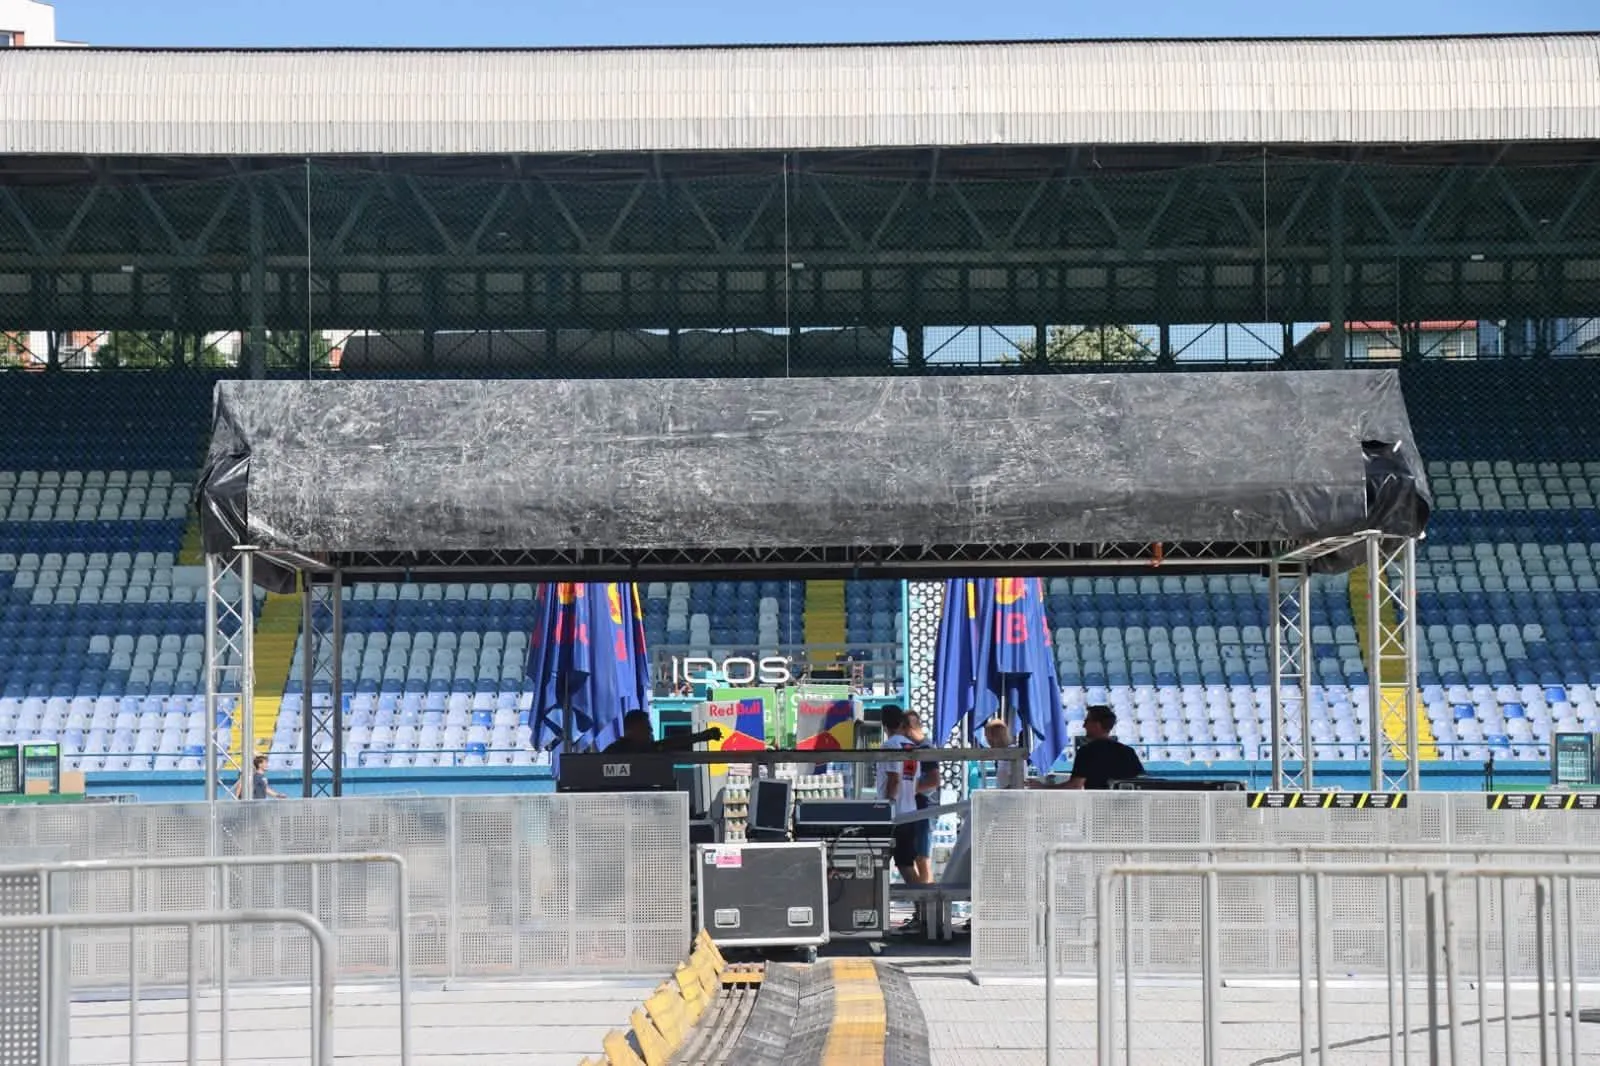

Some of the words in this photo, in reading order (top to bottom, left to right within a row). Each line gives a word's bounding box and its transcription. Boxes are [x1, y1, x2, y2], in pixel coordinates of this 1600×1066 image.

[672, 656, 791, 688] IQOS
[709, 703, 734, 717] Red
[736, 701, 761, 714] Bull
